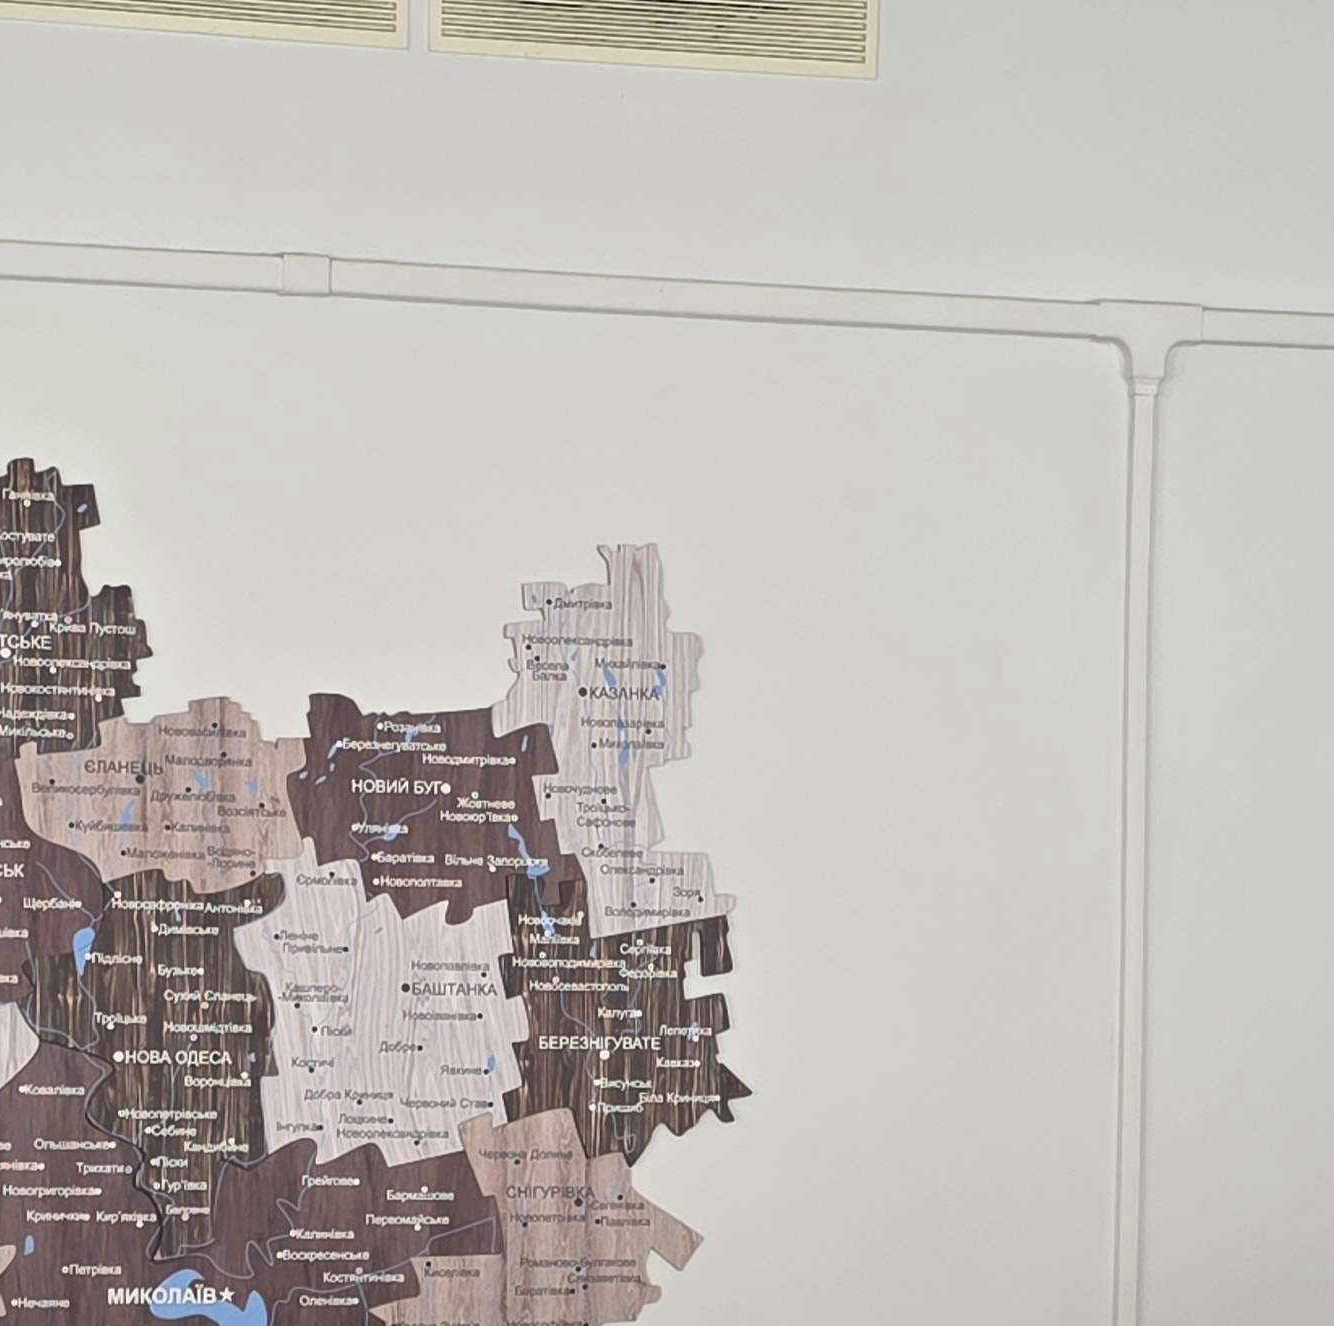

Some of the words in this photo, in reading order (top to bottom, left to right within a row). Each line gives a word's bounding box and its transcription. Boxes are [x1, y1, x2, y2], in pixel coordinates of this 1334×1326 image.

[590, 686, 659, 701] КАЗАНКА
[85, 760, 162, 776] ЄЛАНЕЦЬ
[352, 779, 408, 795] НОВИЙ
[415, 781, 441, 796] БУГ
[412, 982, 497, 998] БАШТАНКА
[539, 1036, 661, 1051] БЕРЕЗНІГУВАТЕ
[126, 1049, 171, 1065] НОВА
[177, 1049, 231, 1066] ОДЕСА
[506, 1185, 594, 1200] СНІГУРІВКА
[107, 1287, 217, 1305] МИКОЛАЇВ
